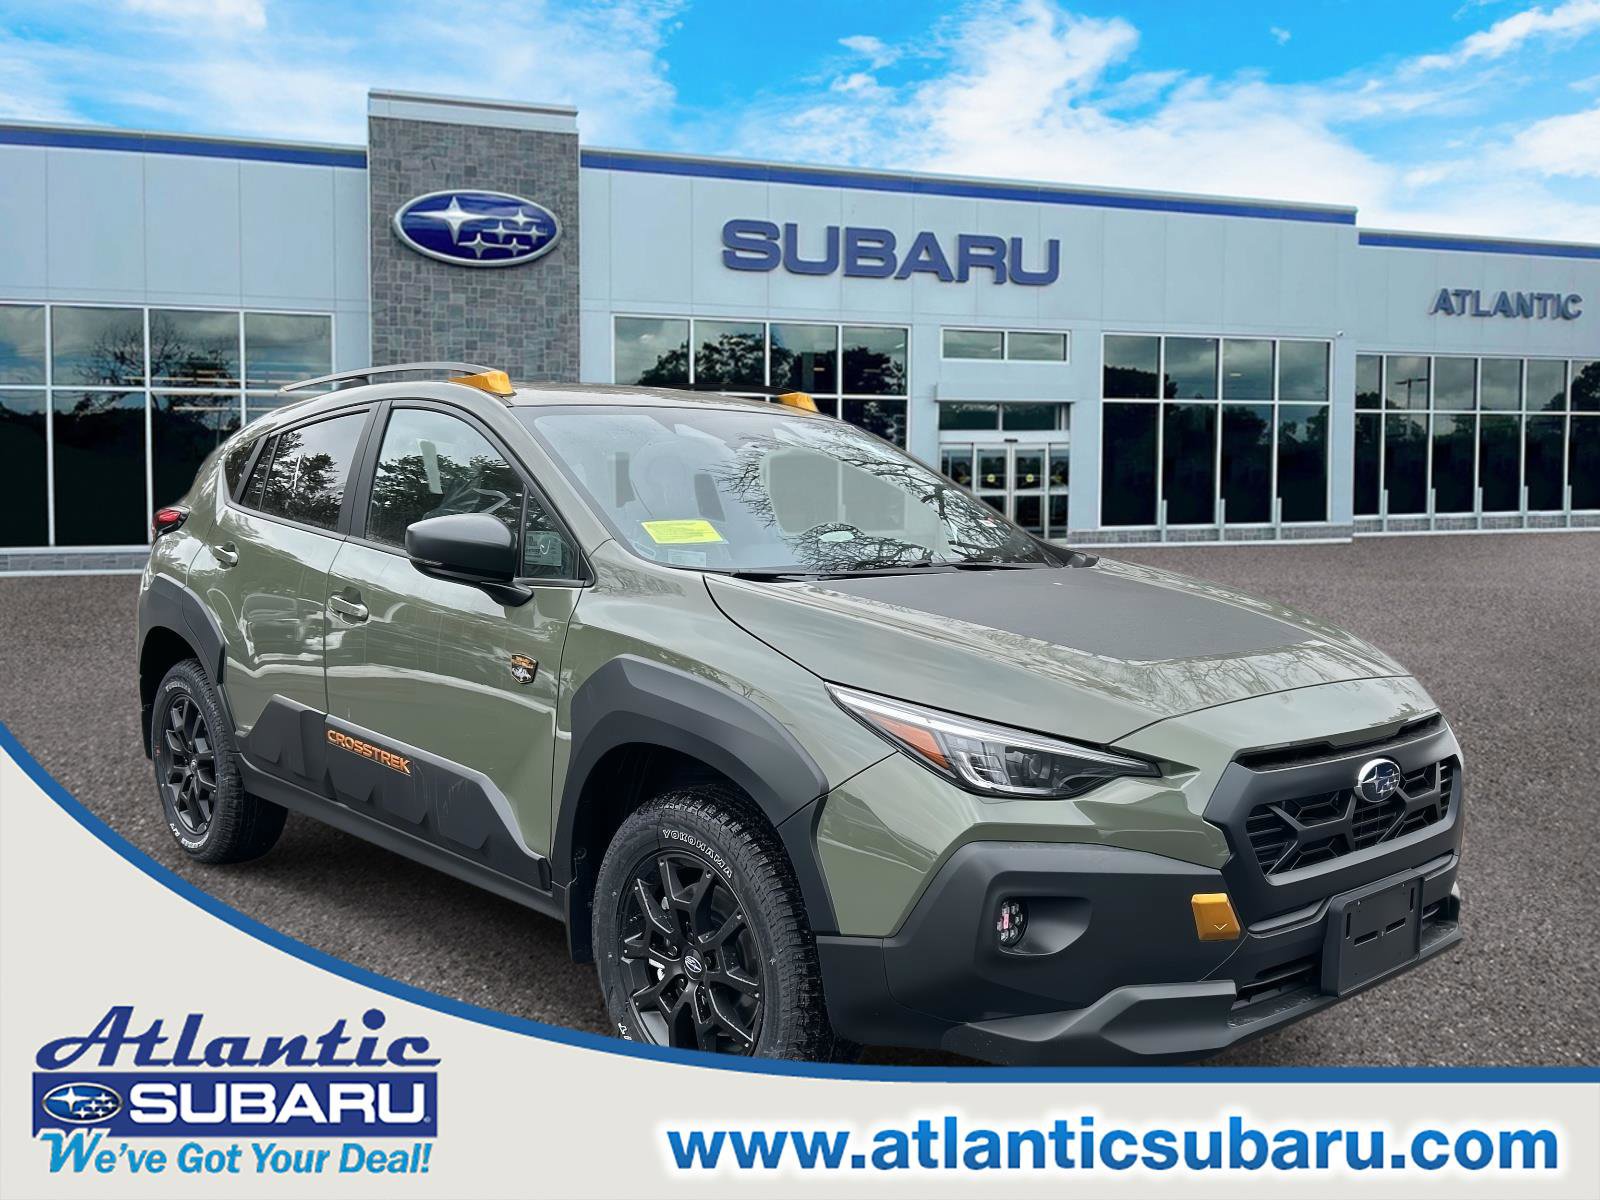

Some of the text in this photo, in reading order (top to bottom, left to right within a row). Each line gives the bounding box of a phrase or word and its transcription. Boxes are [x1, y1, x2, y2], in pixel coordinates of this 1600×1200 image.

[722, 219, 1060, 286] SUBARU
[1430, 288, 1583, 320] ATLANTIC
[327, 729, 411, 774] CROSSTREK
[662, 829, 733, 879] YOKOHAMA
